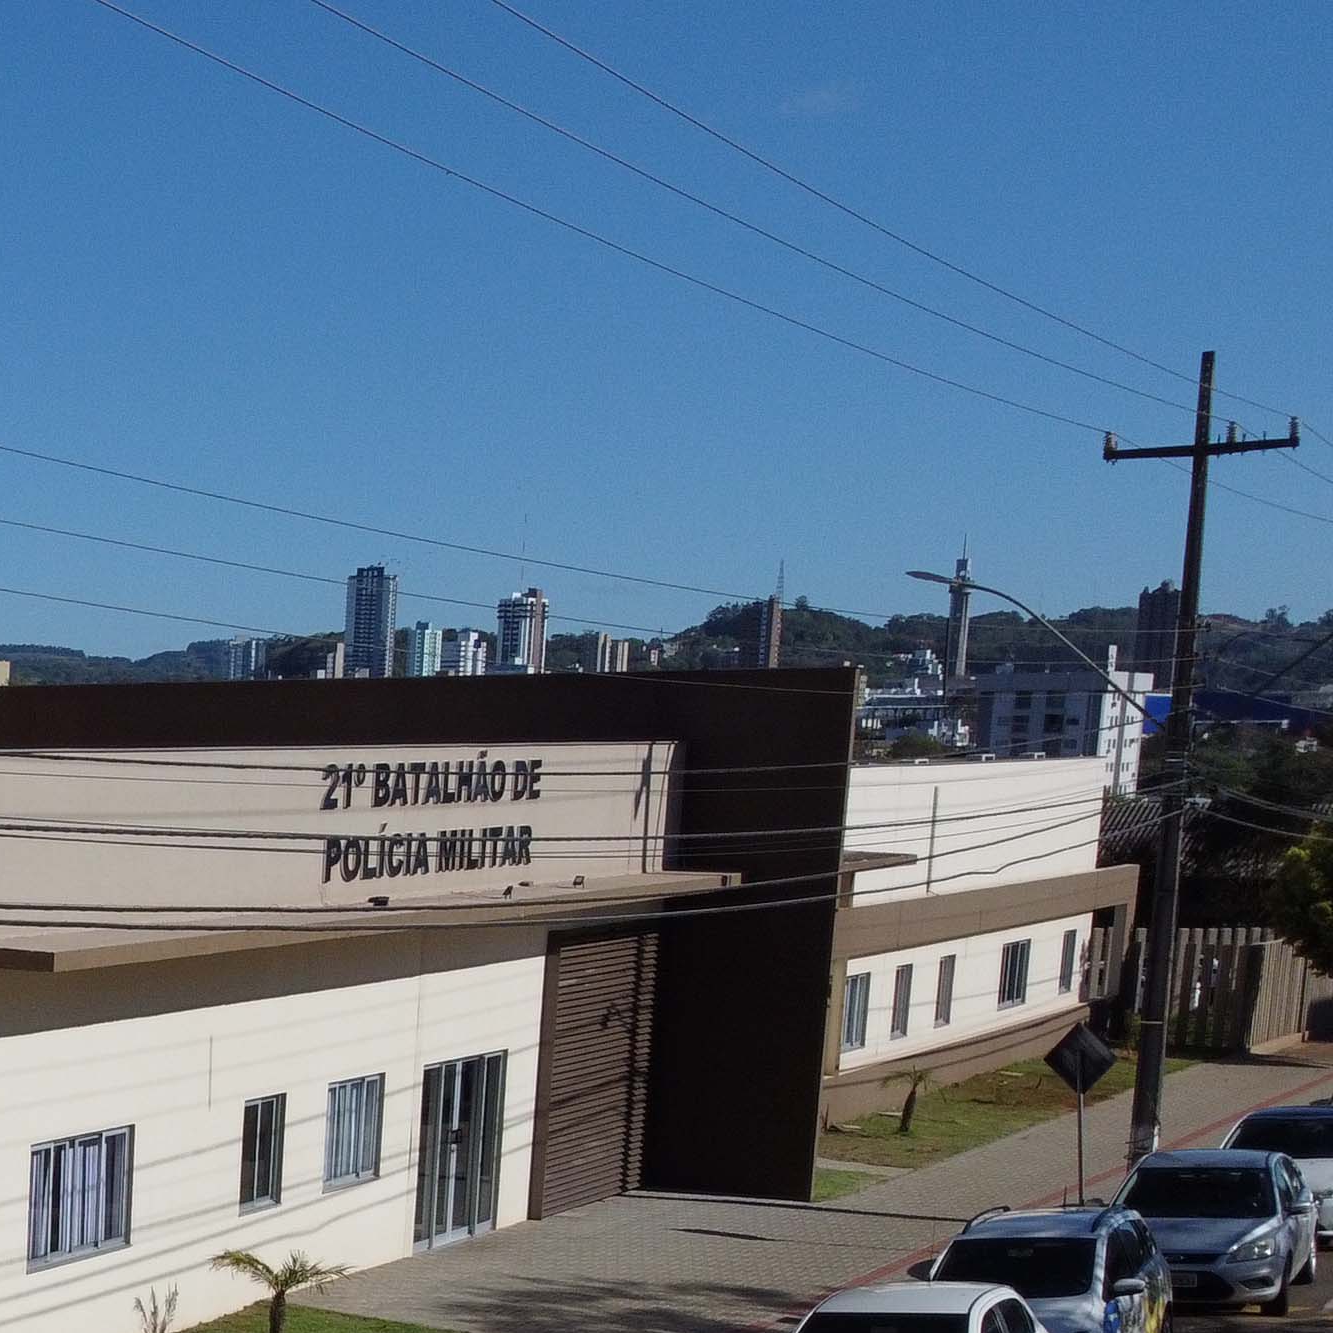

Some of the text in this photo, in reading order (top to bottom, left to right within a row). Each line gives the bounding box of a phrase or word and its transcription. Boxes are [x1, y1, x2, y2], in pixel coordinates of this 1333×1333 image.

[371, 750, 505, 809] BATALHÃO
[510, 759, 543, 802] DE
[321, 823, 533, 883] POLÍCIA MILITAR
